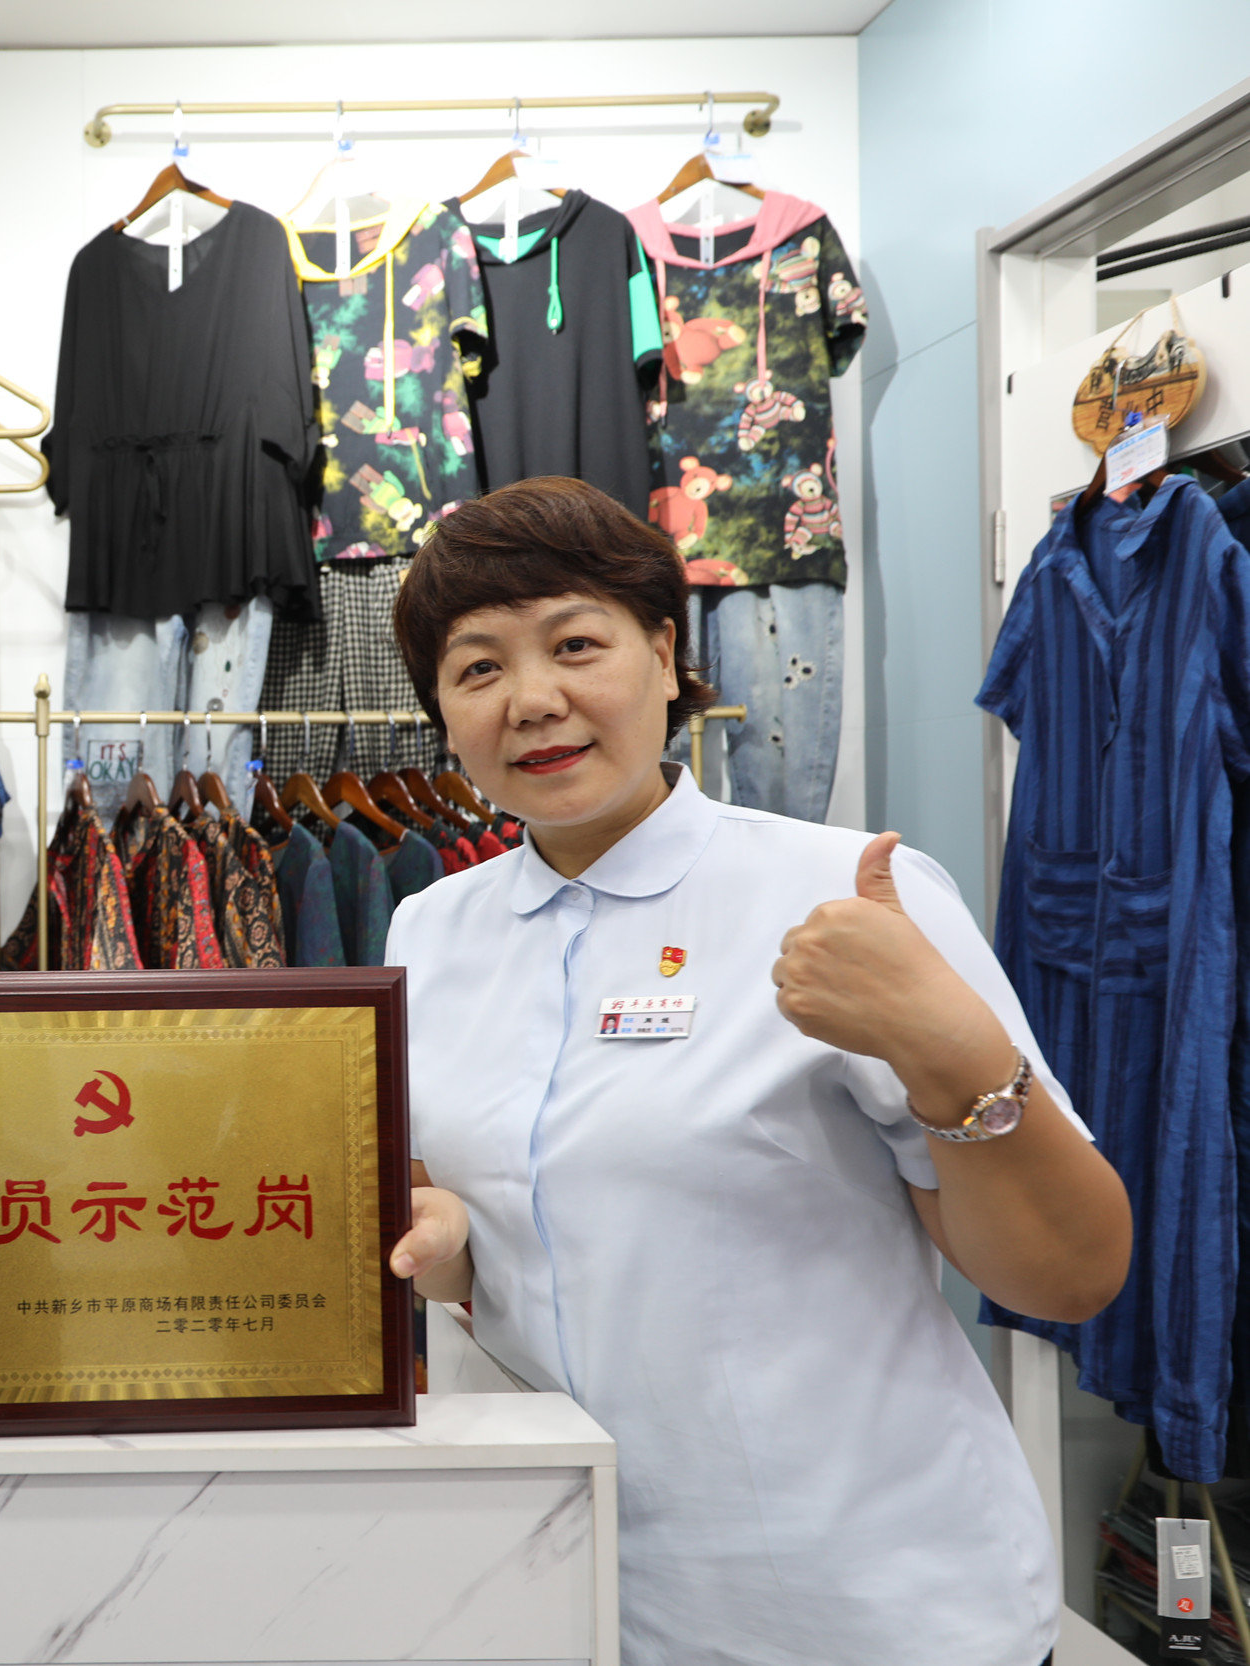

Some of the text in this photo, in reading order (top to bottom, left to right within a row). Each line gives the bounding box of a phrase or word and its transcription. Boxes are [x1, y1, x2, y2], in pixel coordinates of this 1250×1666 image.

[90, 757, 136, 780] OKAY
[17, 1293, 327, 1315] 中共新乡市平原商场有限责任公司委员会
[156, 1317, 274, 1333] 二零二零年七月
